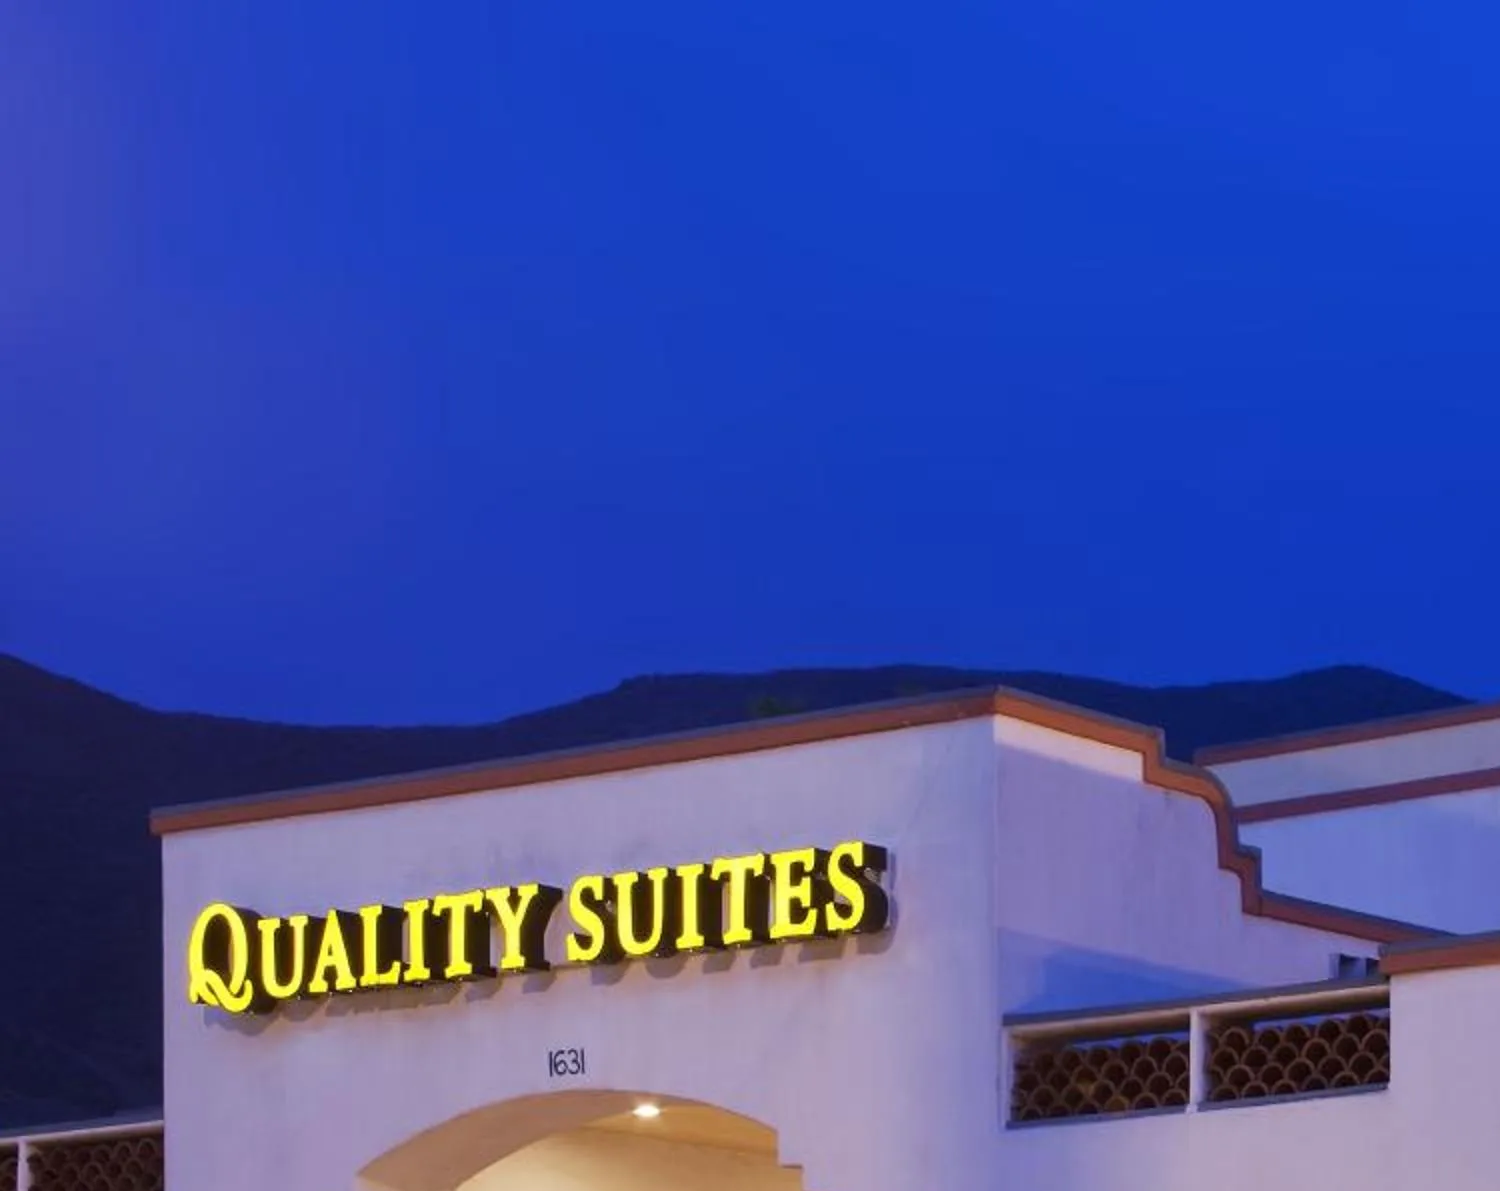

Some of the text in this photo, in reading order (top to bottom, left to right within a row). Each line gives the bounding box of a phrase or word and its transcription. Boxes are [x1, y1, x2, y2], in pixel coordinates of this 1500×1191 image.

[188, 841, 867, 1013] QUALITY SUITES
[549, 1048, 584, 1077] 1631
